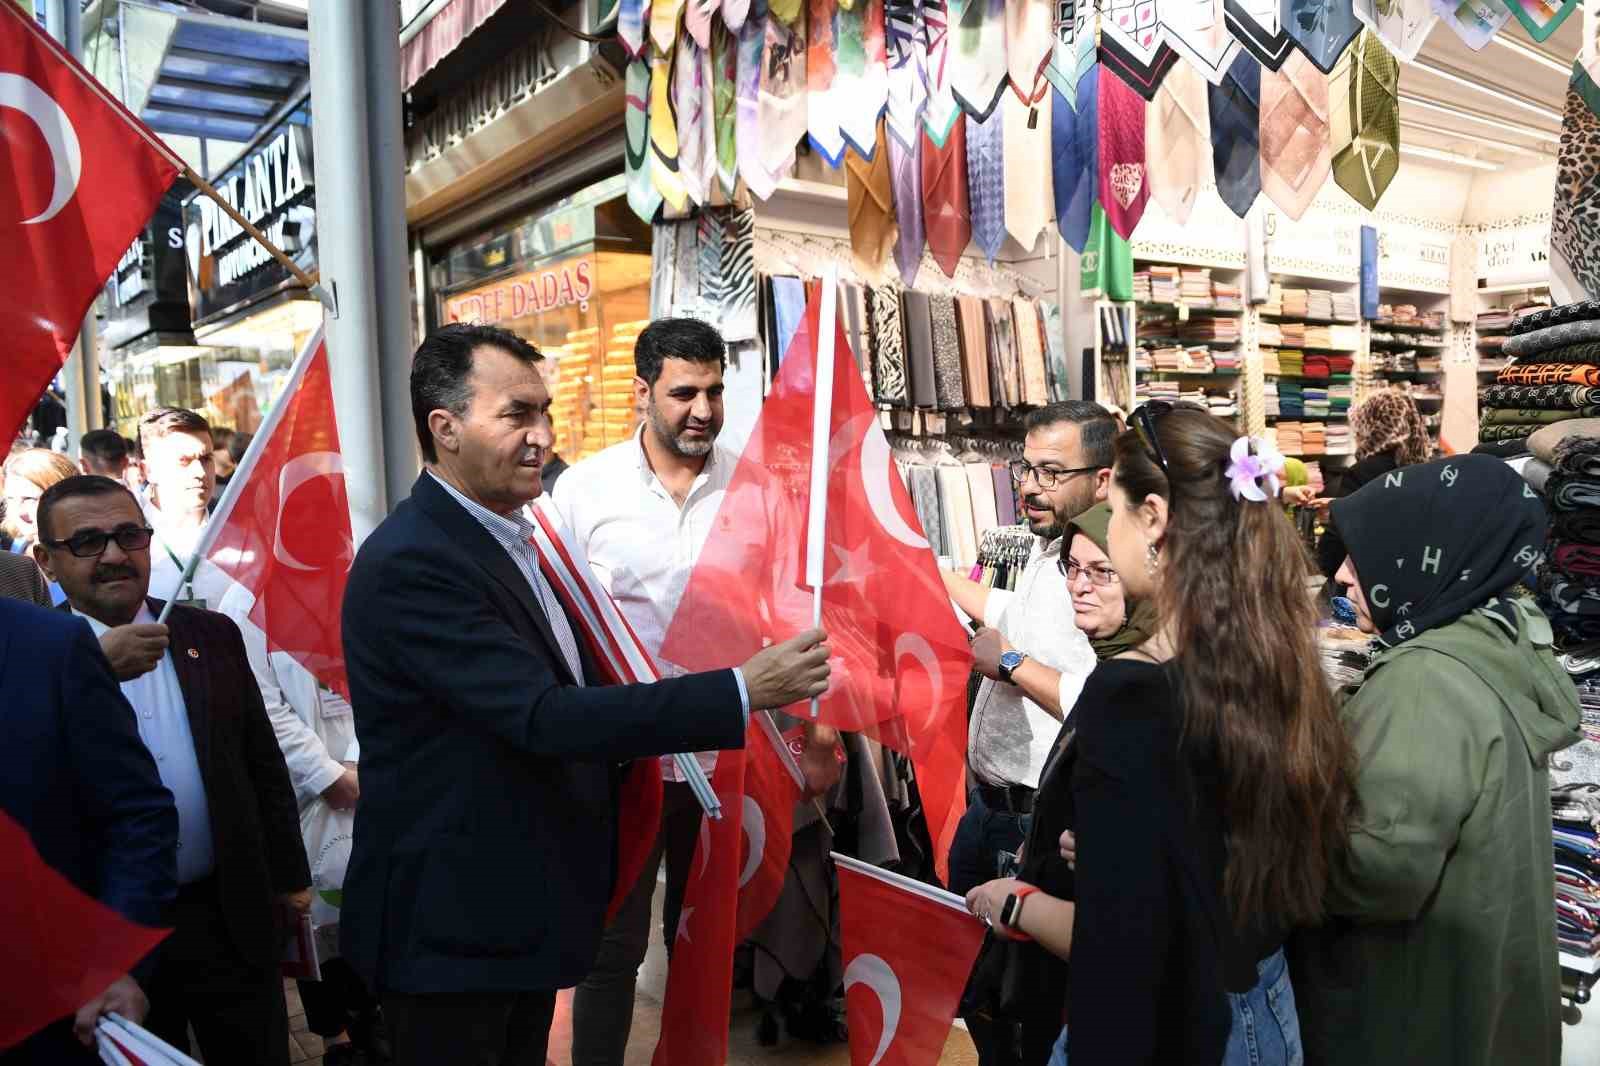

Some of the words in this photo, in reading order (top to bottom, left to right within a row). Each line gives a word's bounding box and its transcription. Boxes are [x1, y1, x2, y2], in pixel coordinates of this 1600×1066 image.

[193, 124, 306, 257] PIRLANTA
[168, 228, 184, 248] S
[512, 261, 593, 313] DADAŞ
[1421, 545, 1442, 574] H
[1370, 584, 1390, 608] C
